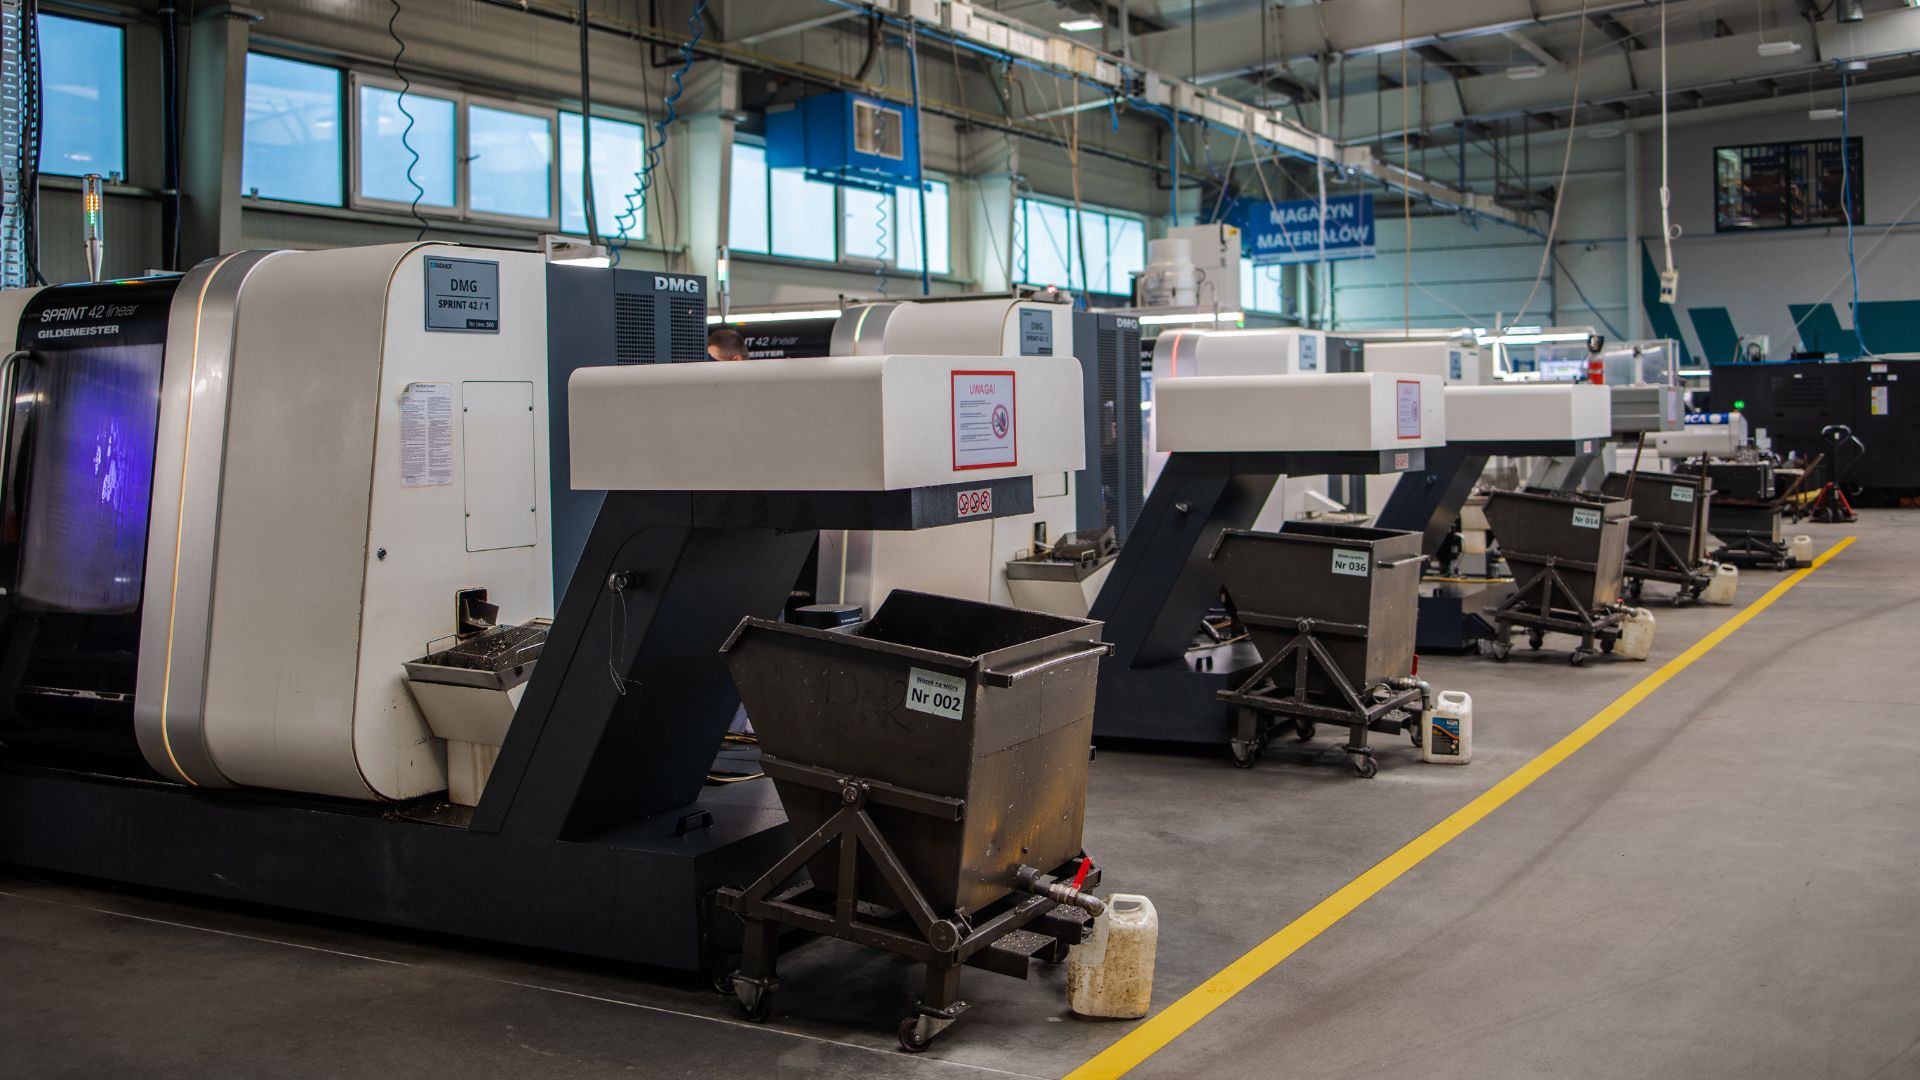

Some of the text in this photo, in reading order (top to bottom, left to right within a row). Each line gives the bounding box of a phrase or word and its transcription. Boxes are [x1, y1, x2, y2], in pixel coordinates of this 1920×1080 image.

[1270, 203, 1353, 224] MAGAZYN
[1257, 224, 1369, 249] MATERIAŁÓW
[450, 279, 477, 292] DMG
[654, 276, 699, 294] DMG
[438, 299, 467, 310] SPRINT
[468, 302, 477, 310] 42
[484, 302, 489, 311] 1
[41, 304, 139, 323] SPRINT 42 linear
[1116, 318, 1138, 329] DMG
[38, 325, 120, 339] GILDEMEISTER
[755, 336, 770, 347] 42
[969, 384, 996, 395] UWAGA!
[1335, 561, 1366, 571] Nr 036
[911, 687, 961, 712] Nr 002
